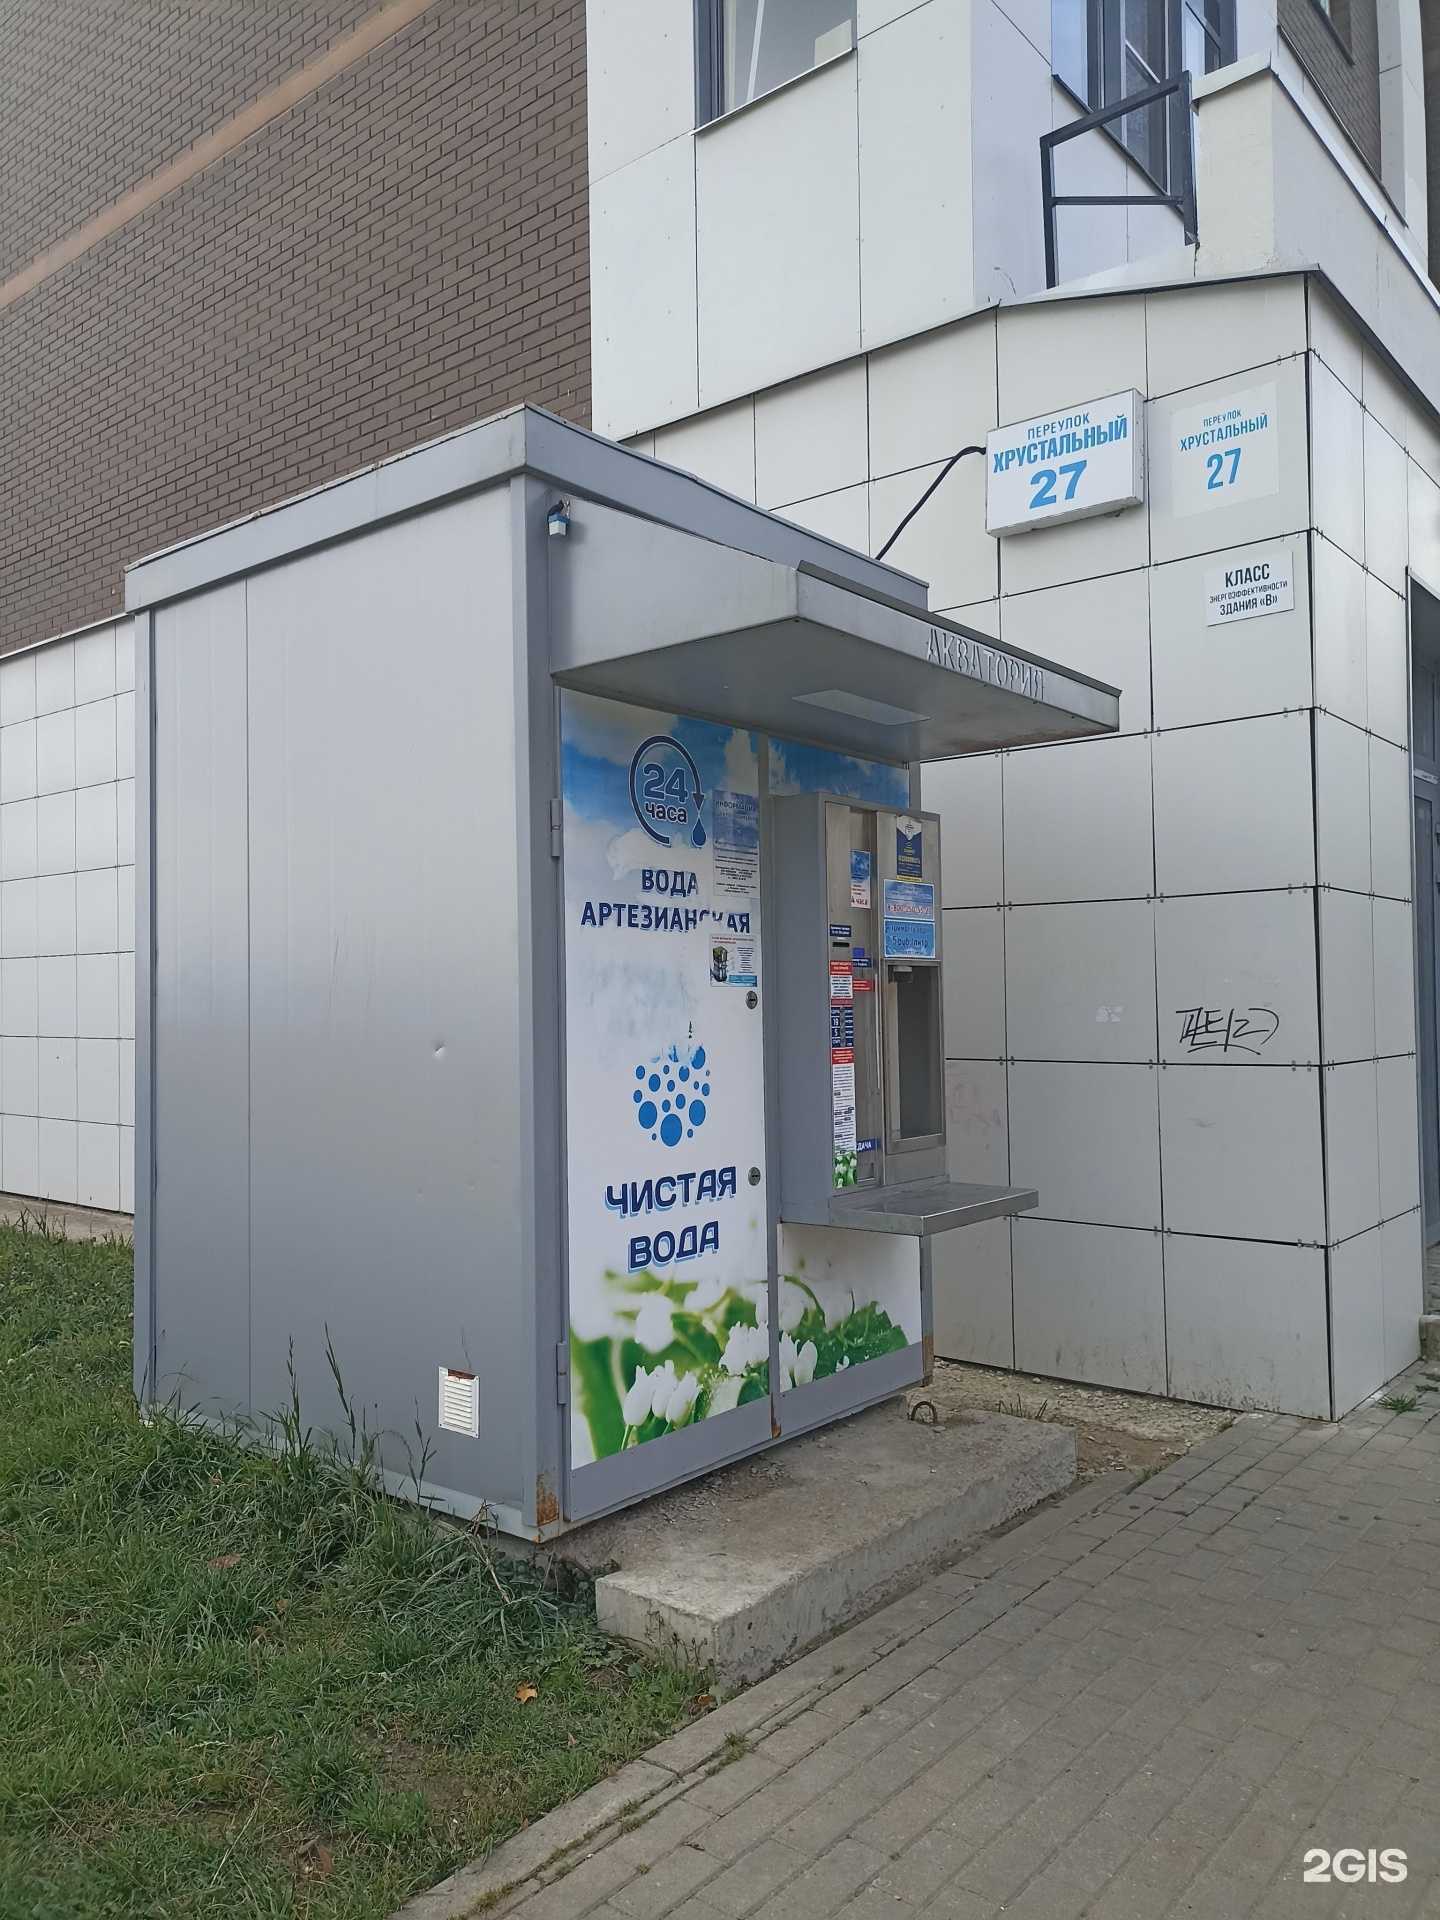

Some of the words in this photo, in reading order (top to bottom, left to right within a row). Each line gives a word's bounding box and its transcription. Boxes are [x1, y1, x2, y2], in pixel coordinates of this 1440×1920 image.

[1027, 412, 1090, 441] ПЕРЕУЛОК
[1179, 412, 1268, 452] ХРУСТАЛЬНЫЙ
[1203, 408, 1242, 428] ПЕРЕУЛОК
[992, 414, 1129, 474] ХРУСТАЛЬНЫЙ
[1029, 459, 1088, 510] 27
[1206, 447, 1242, 490] 27
[1209, 580, 1288, 604] ЭНЕРГОЭФФЕКТИВНОСТИ
[1225, 563, 1270, 588] КЛАСС
[1219, 597, 1258, 616] ЗДАНИЯ
[926, 628, 1045, 700] АКВАТОРИЯ
[642, 763, 688, 803] 24
[640, 868, 699, 897] ВОДА
[605, 1166, 736, 1218] ЧИСТАЯ
[629, 1220, 719, 1272] ВОДА
